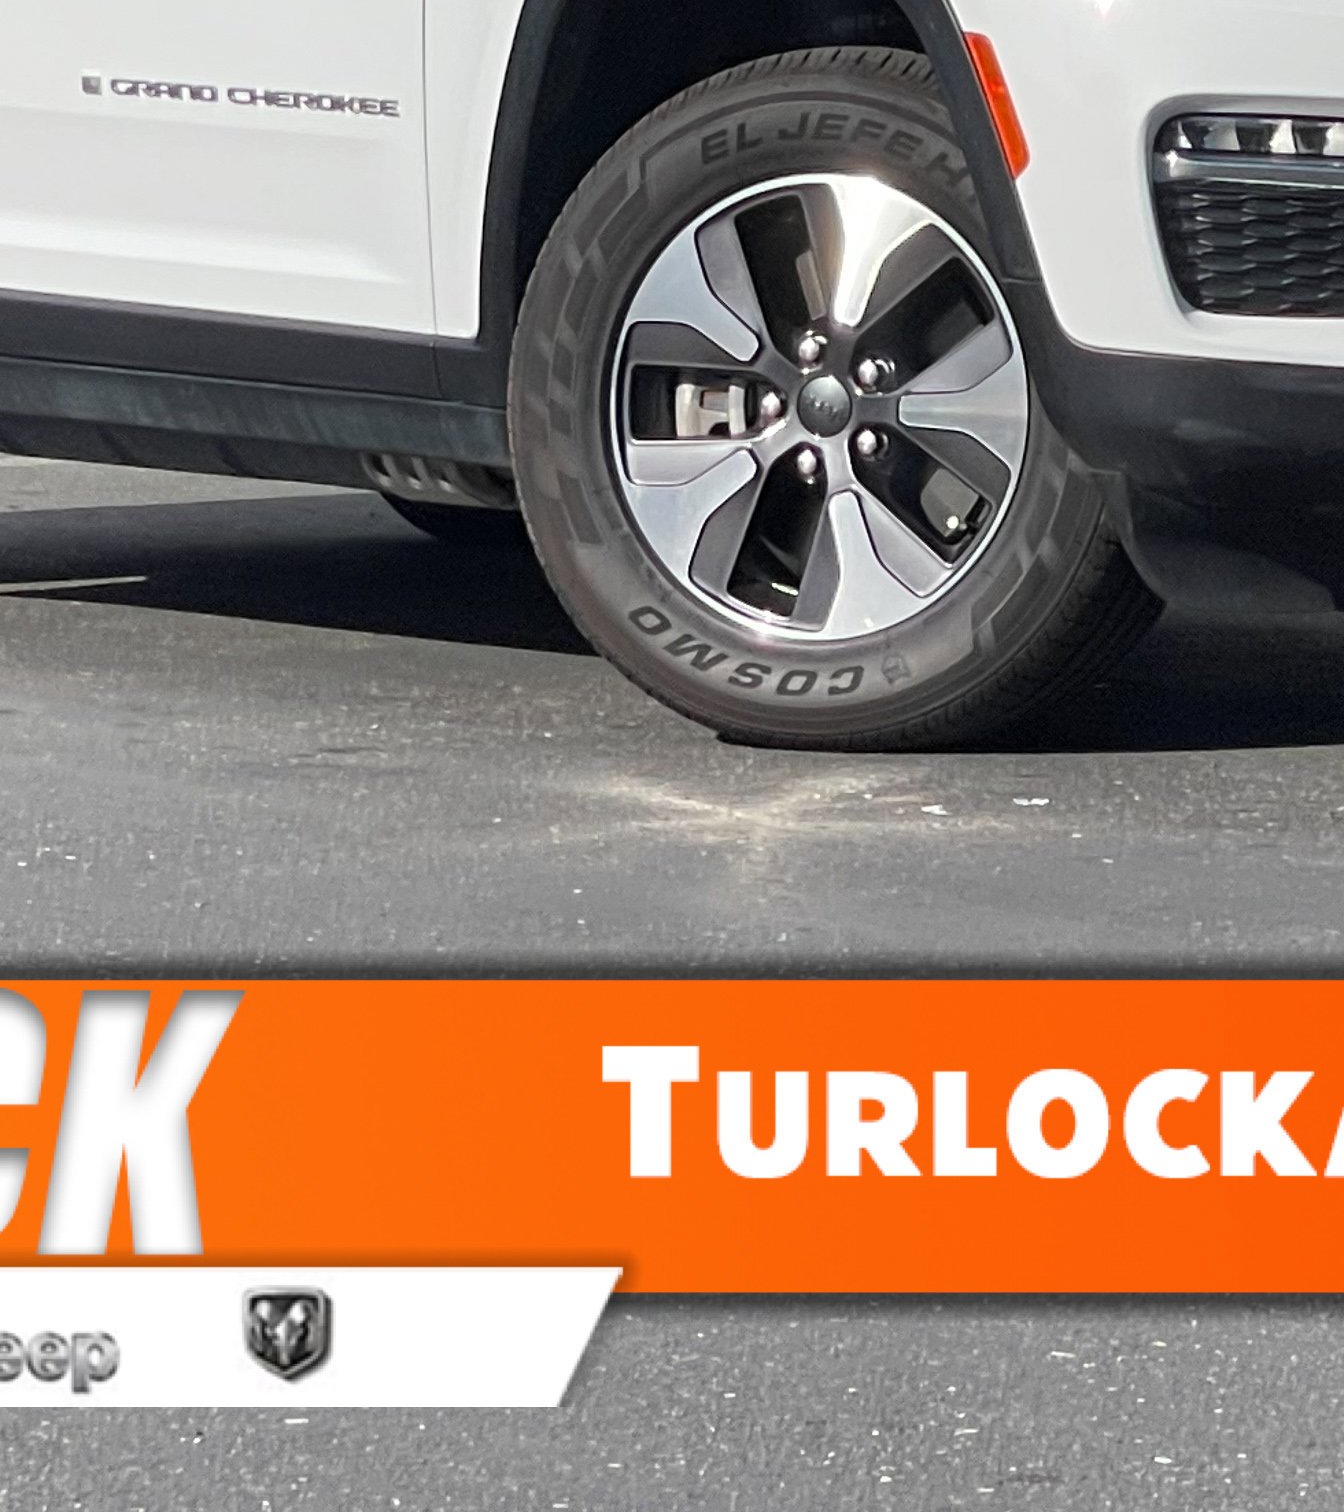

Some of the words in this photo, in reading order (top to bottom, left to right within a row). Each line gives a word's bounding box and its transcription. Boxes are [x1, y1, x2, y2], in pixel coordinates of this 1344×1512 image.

[110, 78, 219, 103] GRAND
[227, 87, 401, 118] CHEROKEE
[701, 122, 762, 165] EL
[778, 112, 924, 154] JEFE
[628, 605, 865, 697] COSMO
